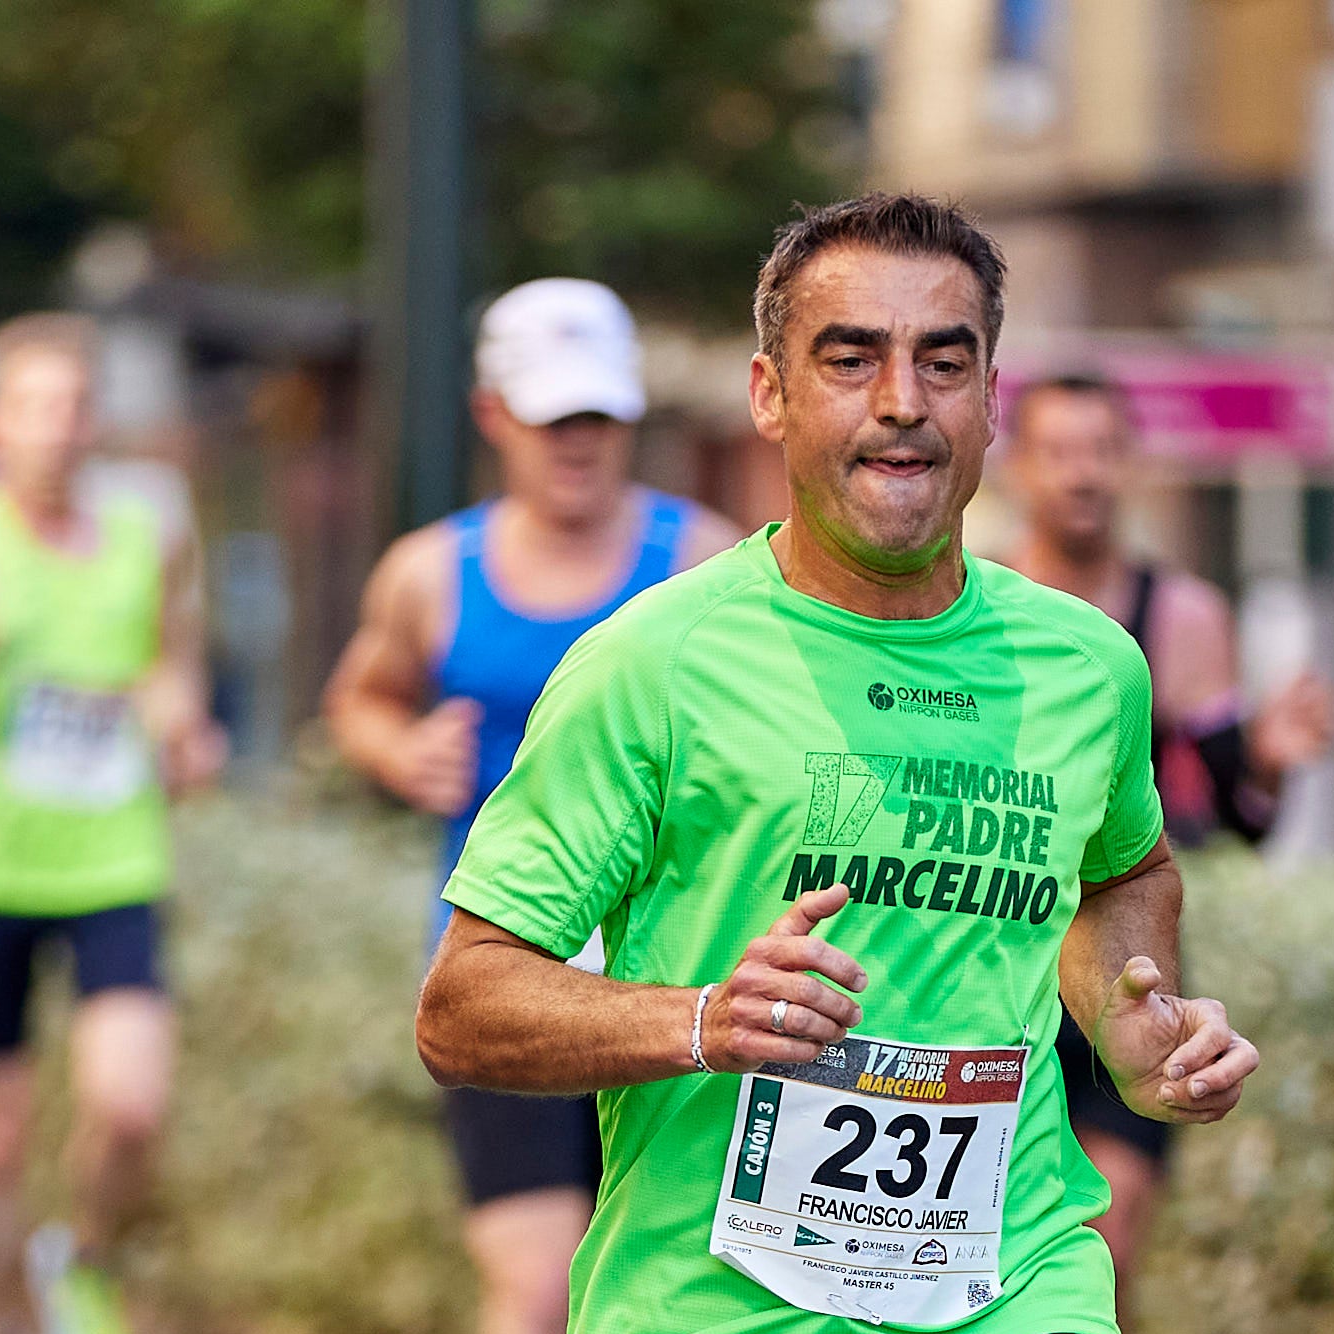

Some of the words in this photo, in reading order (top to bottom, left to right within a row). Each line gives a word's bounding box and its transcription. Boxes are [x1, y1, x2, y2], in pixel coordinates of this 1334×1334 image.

[896, 687, 977, 709] OXIMESA
[898, 703, 940, 718] NIPPON
[943, 709, 980, 722] GASES
[901, 757, 1058, 814] MEMORIAL
[803, 752, 903, 846] 17
[901, 799, 1053, 867] PADRE
[782, 853, 1059, 926] MARCELINO
[863, 1043, 900, 1075] 17
[896, 1049, 950, 1065] MEMORIAL
[977, 1060, 1020, 1073] OXIMESA
[895, 1061, 946, 1082] PADRE
[997, 1073, 1019, 1081] GASES
[856, 1073, 947, 1100] MARCELINO
[757, 1101, 775, 1115] 3
[745, 1118, 772, 1176] CAJÓN
[810, 1103, 979, 1200] 237
[797, 1192, 913, 1230] FRANCISCO
[916, 1211, 968, 1230] JAVIER
[731, 1217, 783, 1235] CALERO
[862, 1240, 905, 1254] OXIMESA
[802, 1259, 847, 1274] FRANCISCO
[848, 1268, 874, 1278] JAVIER
[874, 1271, 909, 1280] CASTILLO
[910, 1273, 939, 1282] JIMENEZ
[842, 1277, 882, 1290] MASTER
[883, 1281, 895, 1291] 45
